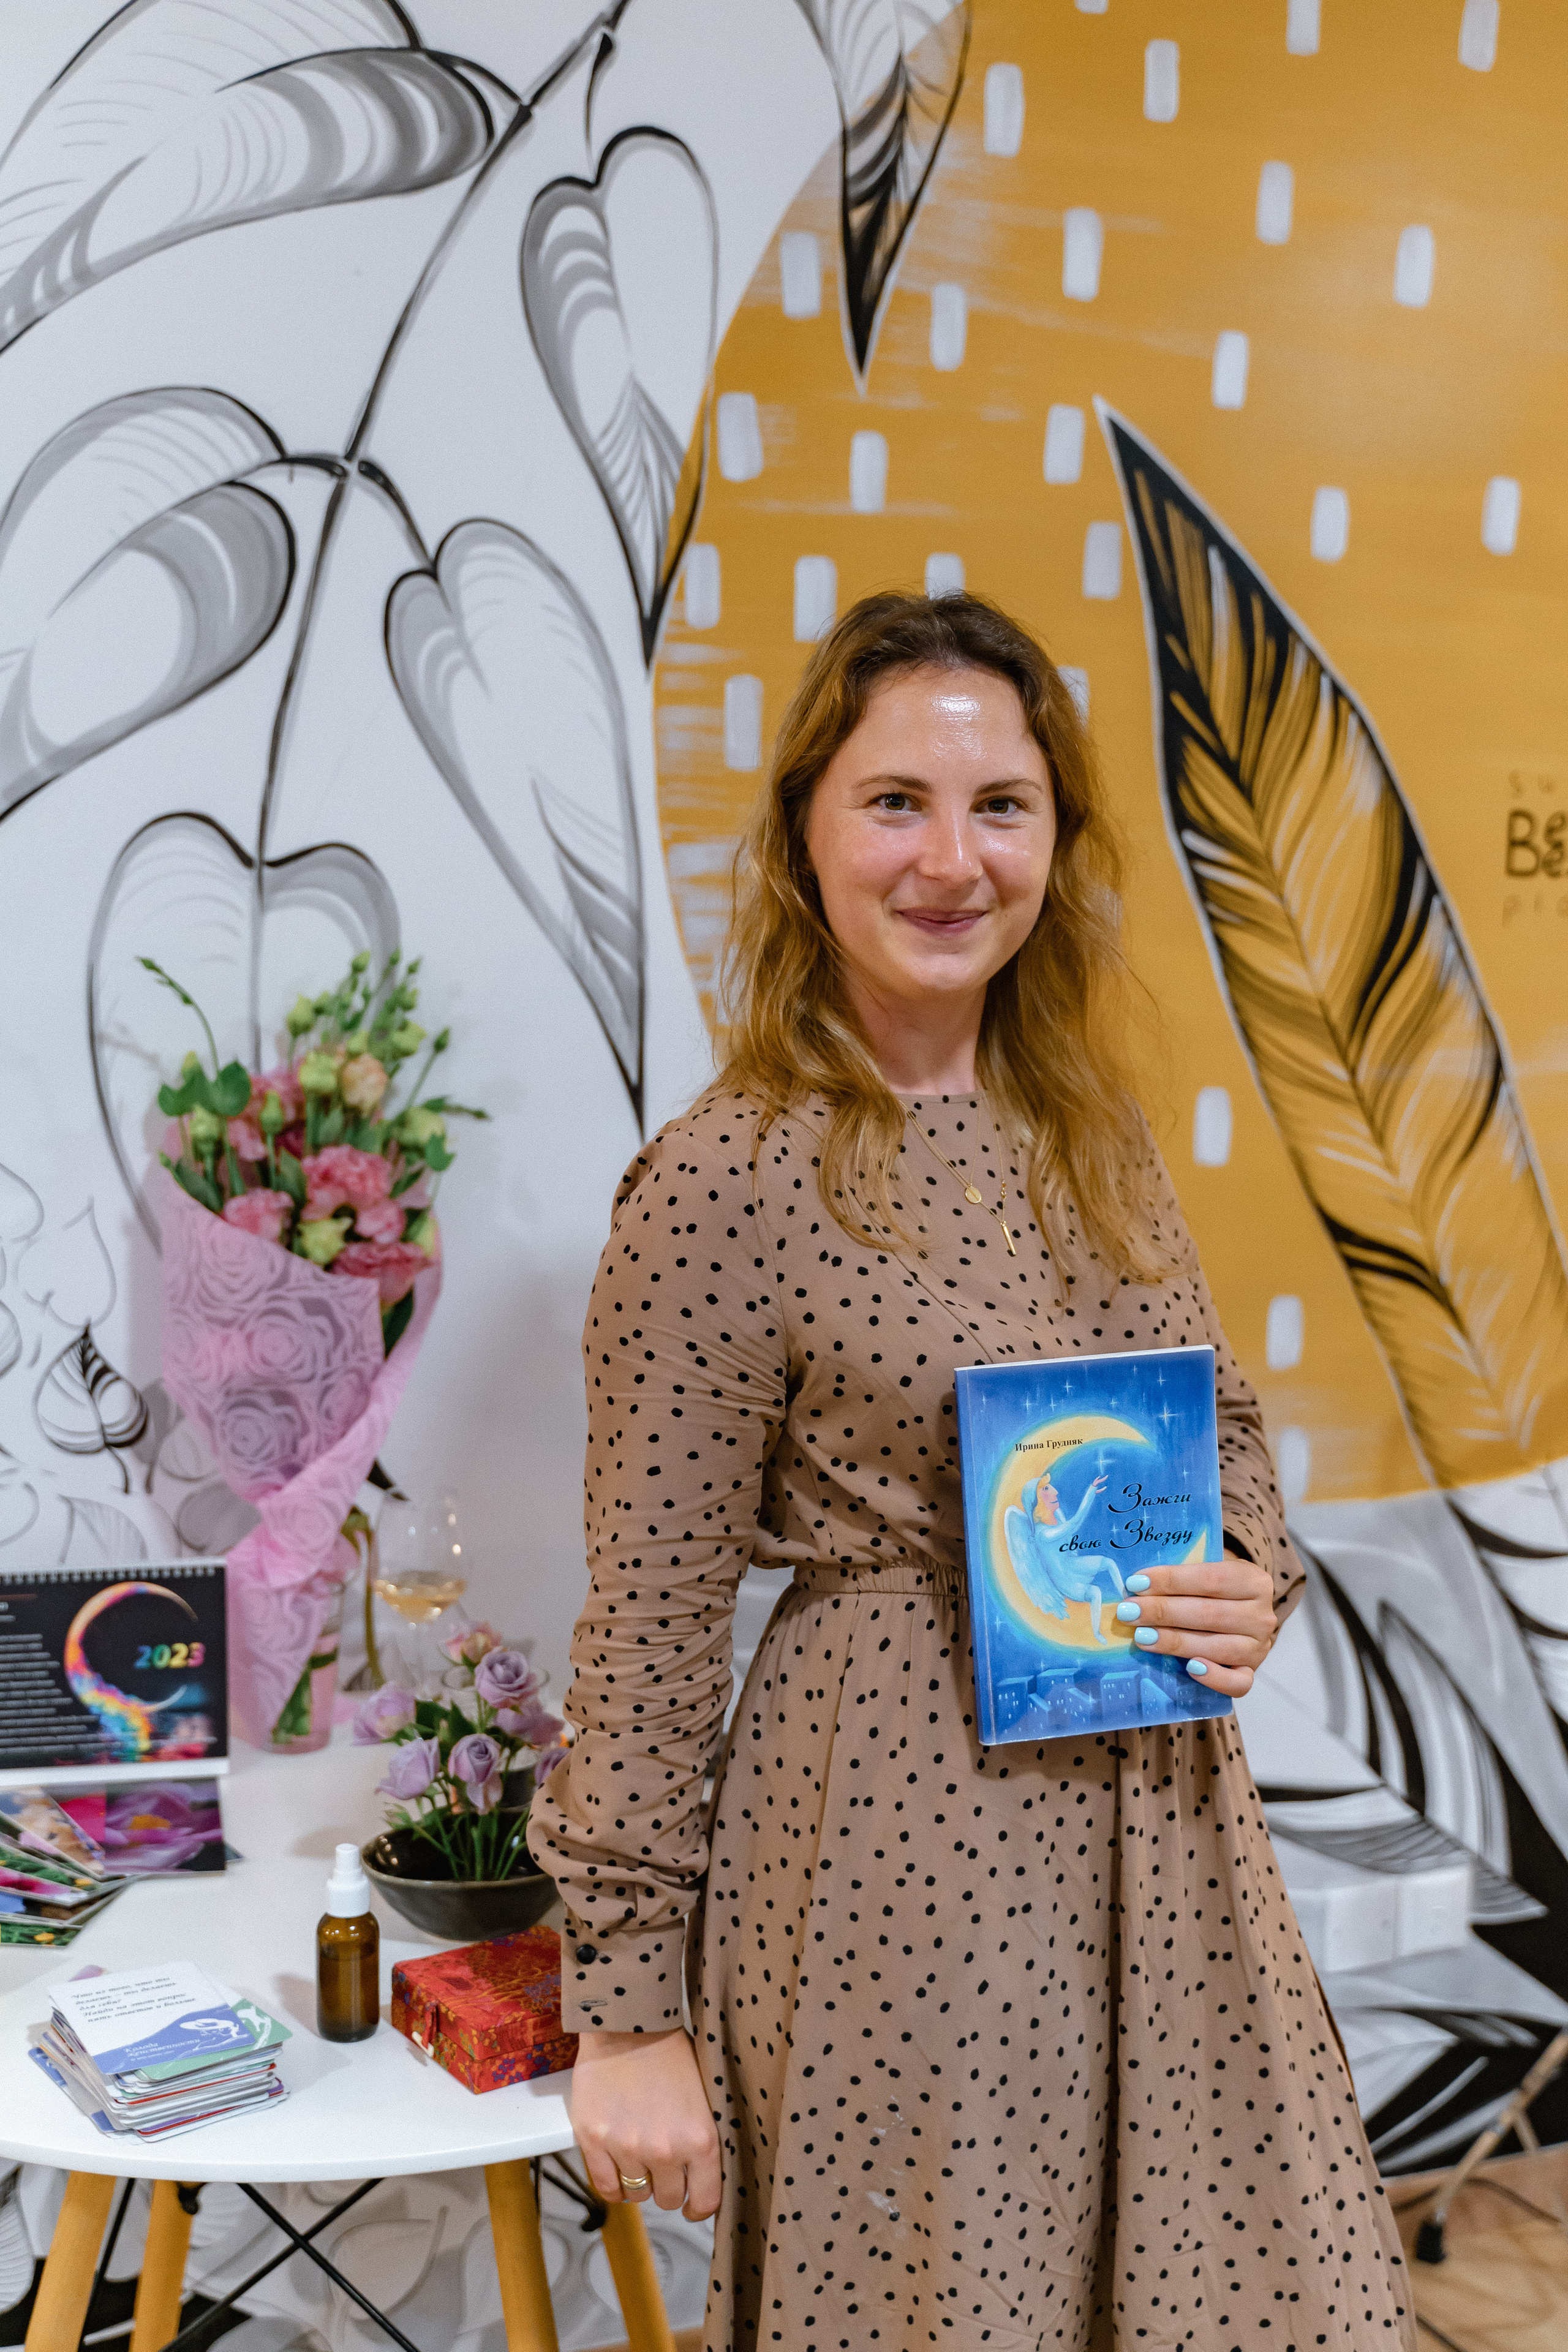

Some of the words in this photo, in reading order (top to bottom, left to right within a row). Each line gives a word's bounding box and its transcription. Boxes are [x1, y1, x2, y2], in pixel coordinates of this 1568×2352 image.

[1015, 1443, 1044, 1452] Ирина
[1047, 1439, 1083, 1449] Грудняк
[1107, 1483, 1191, 1513] Зажги
[1059, 1534, 1102, 1552] свою
[1109, 1519, 1193, 1549] Звезду
[134, 1642, 206, 1669] 2023
